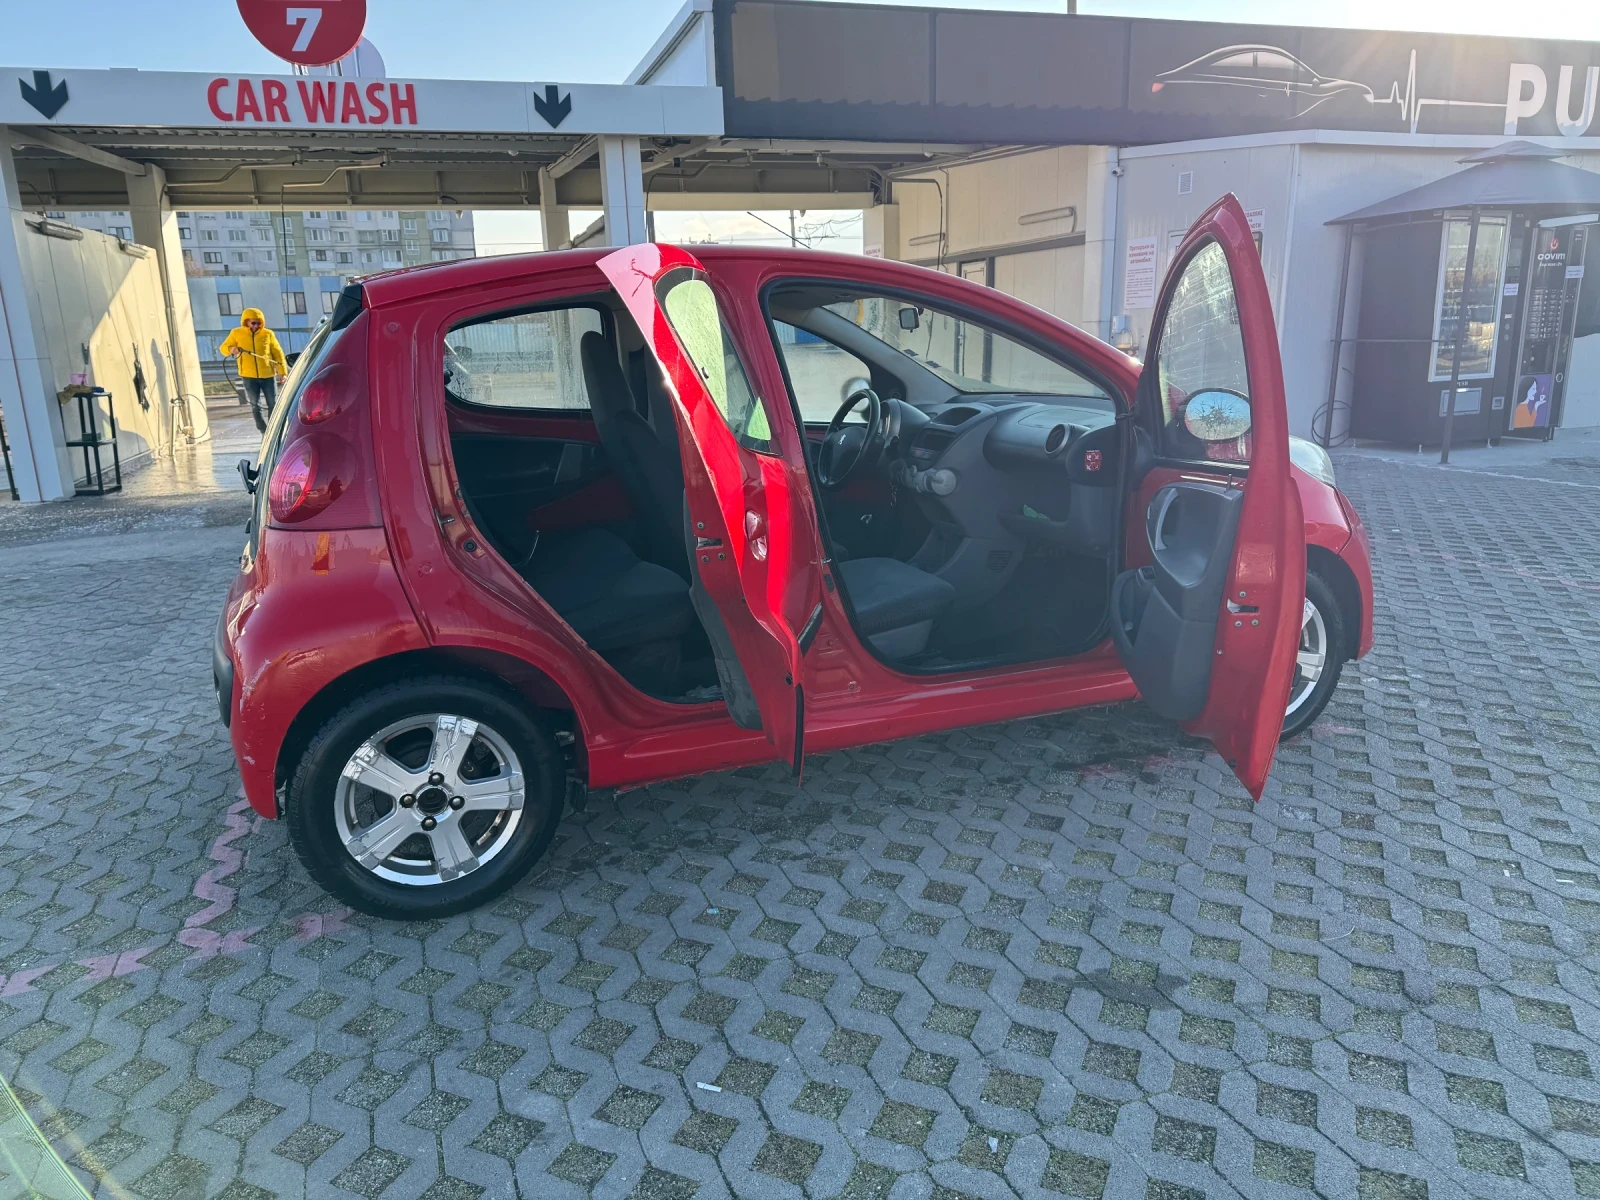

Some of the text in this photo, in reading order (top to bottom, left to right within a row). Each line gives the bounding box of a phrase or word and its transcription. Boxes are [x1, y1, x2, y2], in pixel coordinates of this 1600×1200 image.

[286, 8, 323, 52] 7
[207, 77, 418, 125] CAR WASH
[1503, 63, 1600, 137] PU
